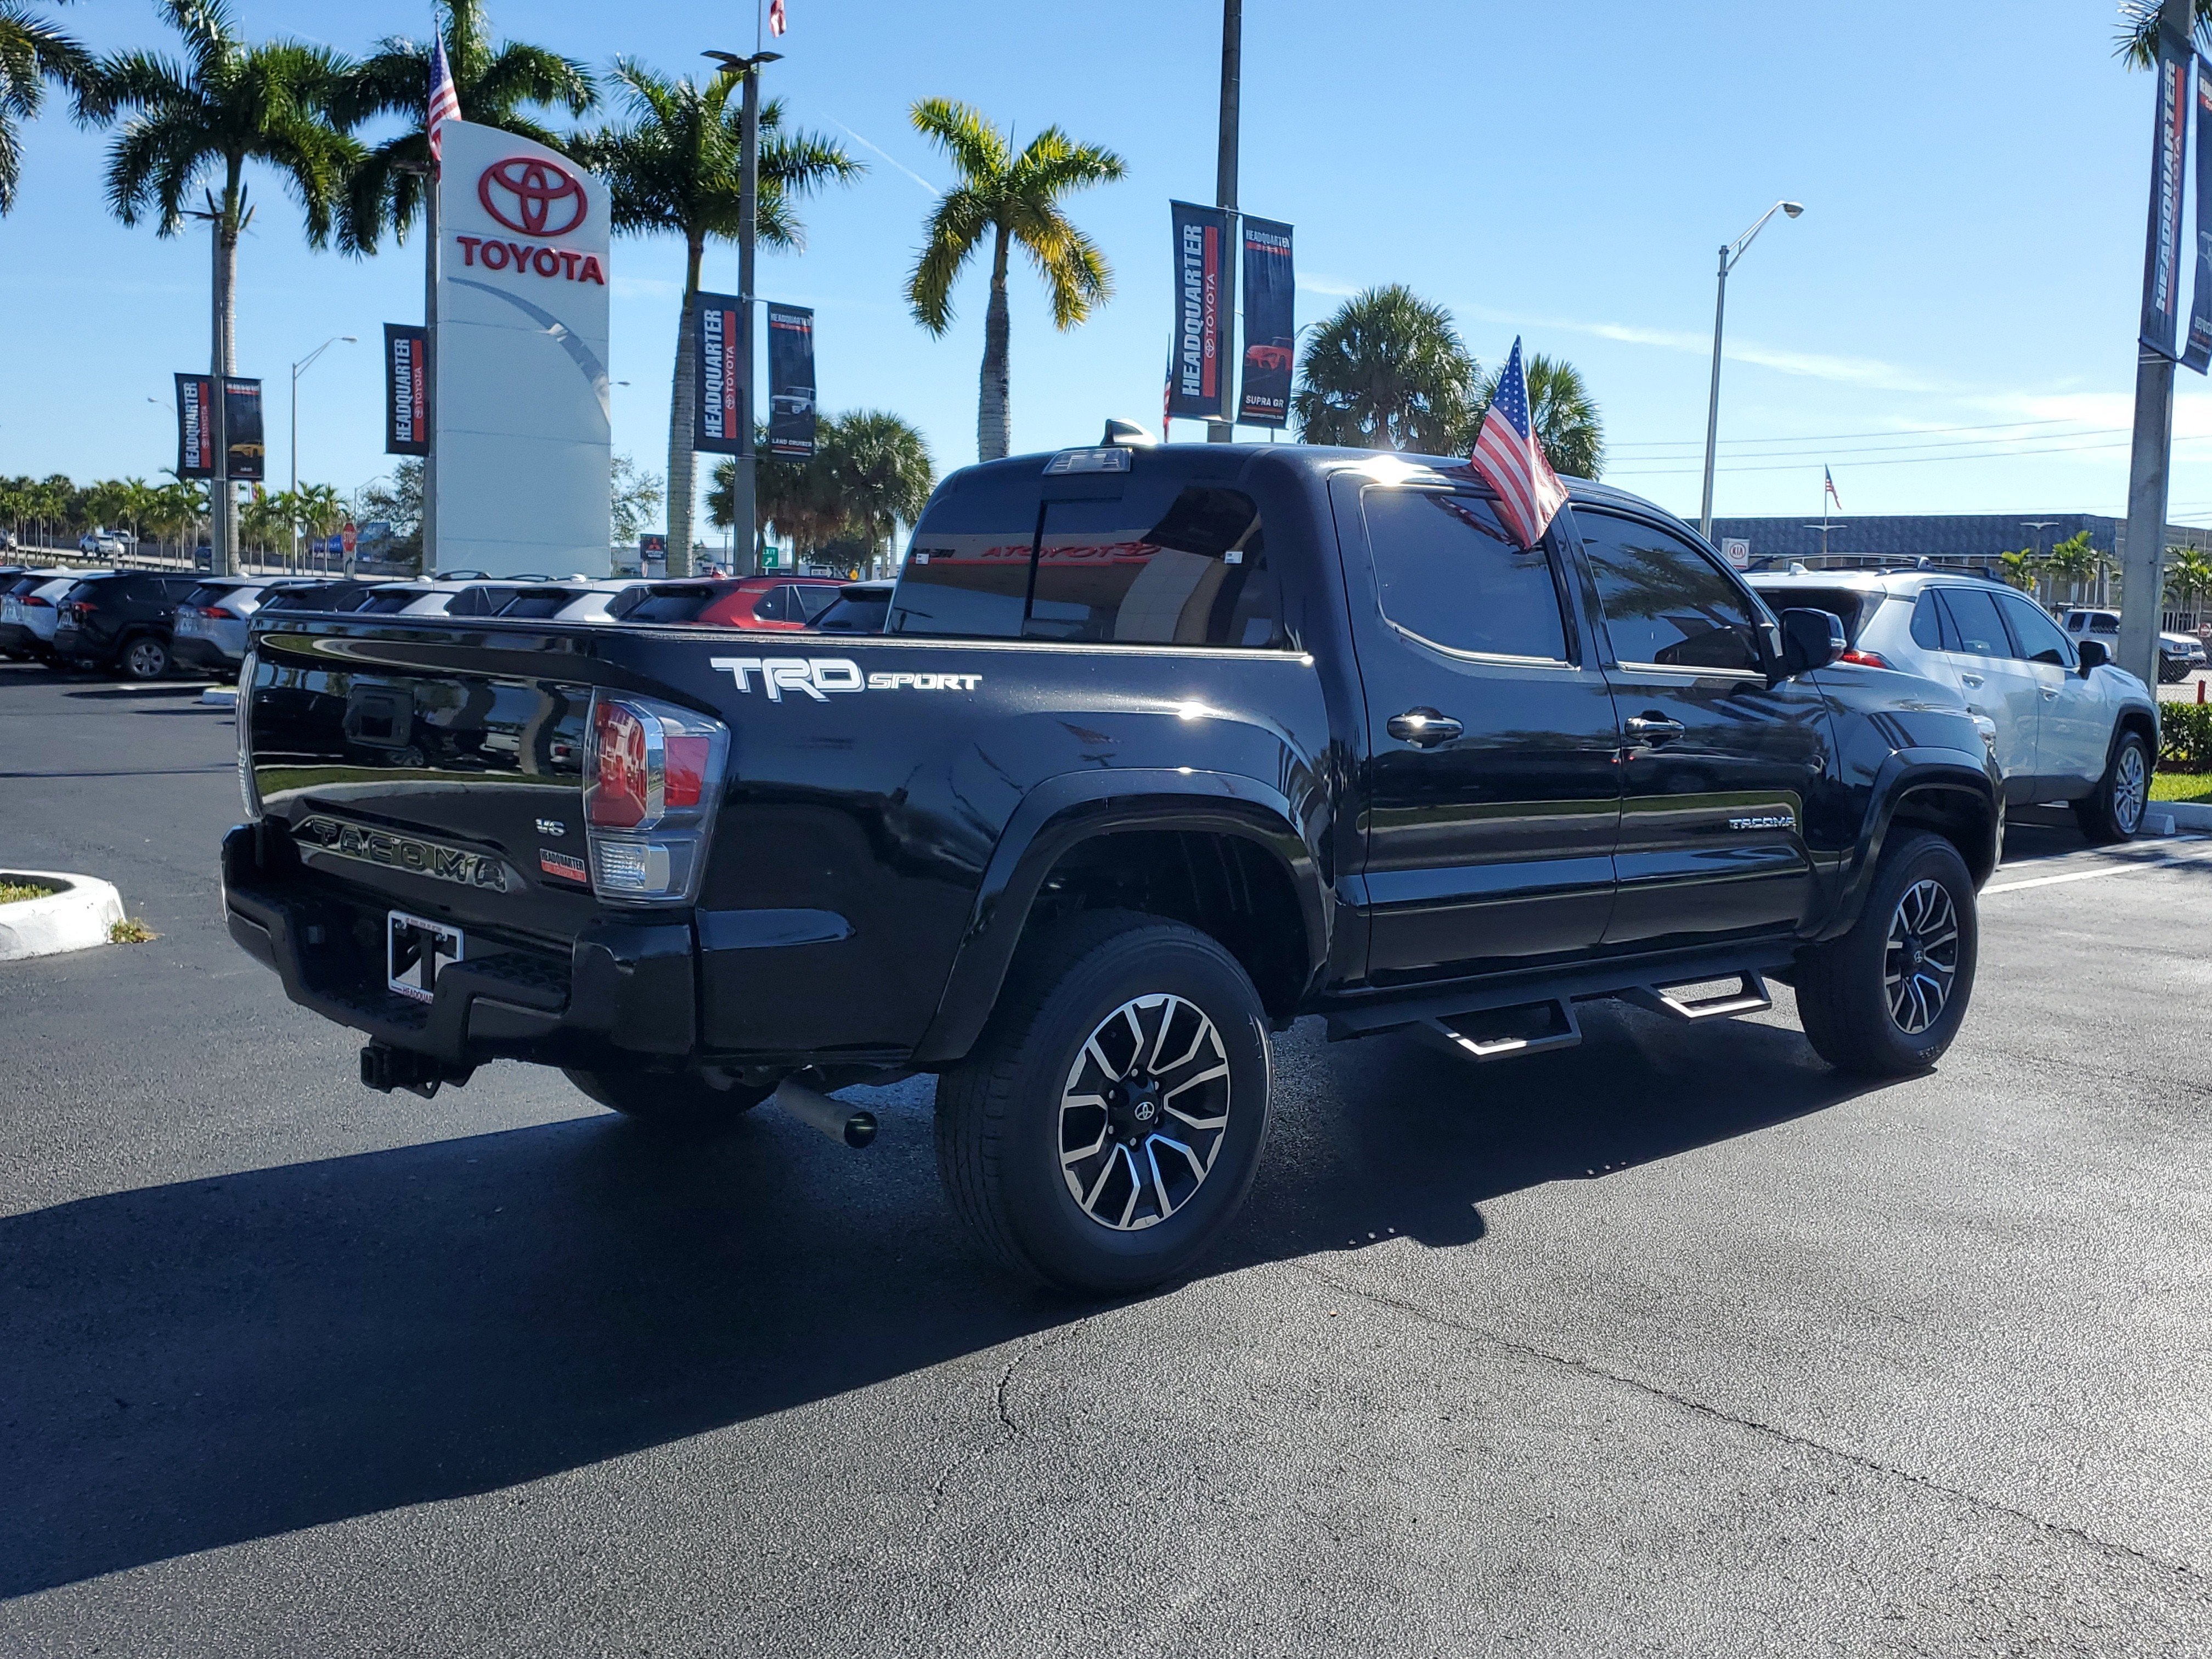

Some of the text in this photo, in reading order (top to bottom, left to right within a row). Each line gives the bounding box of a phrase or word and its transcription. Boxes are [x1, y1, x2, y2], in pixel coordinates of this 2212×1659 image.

[2156, 59, 2175, 312] HEADQUARTER
[457, 235, 604, 285] TOYOTA
[1182, 224, 1204, 397] HEADQUARTER
[1205, 274, 1215, 336] TOYOTA
[394, 338, 413, 442] HEADQUARTER
[703, 309, 724, 438] HEADQUARTER
[725, 346, 735, 393] TOYOTA
[183, 382, 200, 467] HEADQUARTER
[1245, 394, 1284, 408] SUPRA GR
[344, 532, 356, 543] STOP
[1732, 546, 1743, 555] KIA
[710, 658, 983, 703] TRD SPORT
[535, 817, 566, 837] V6
[1729, 816, 1797, 829] TACOMA
[313, 819, 507, 893] TACOMA
[541, 850, 585, 872] HEADQUARTER
